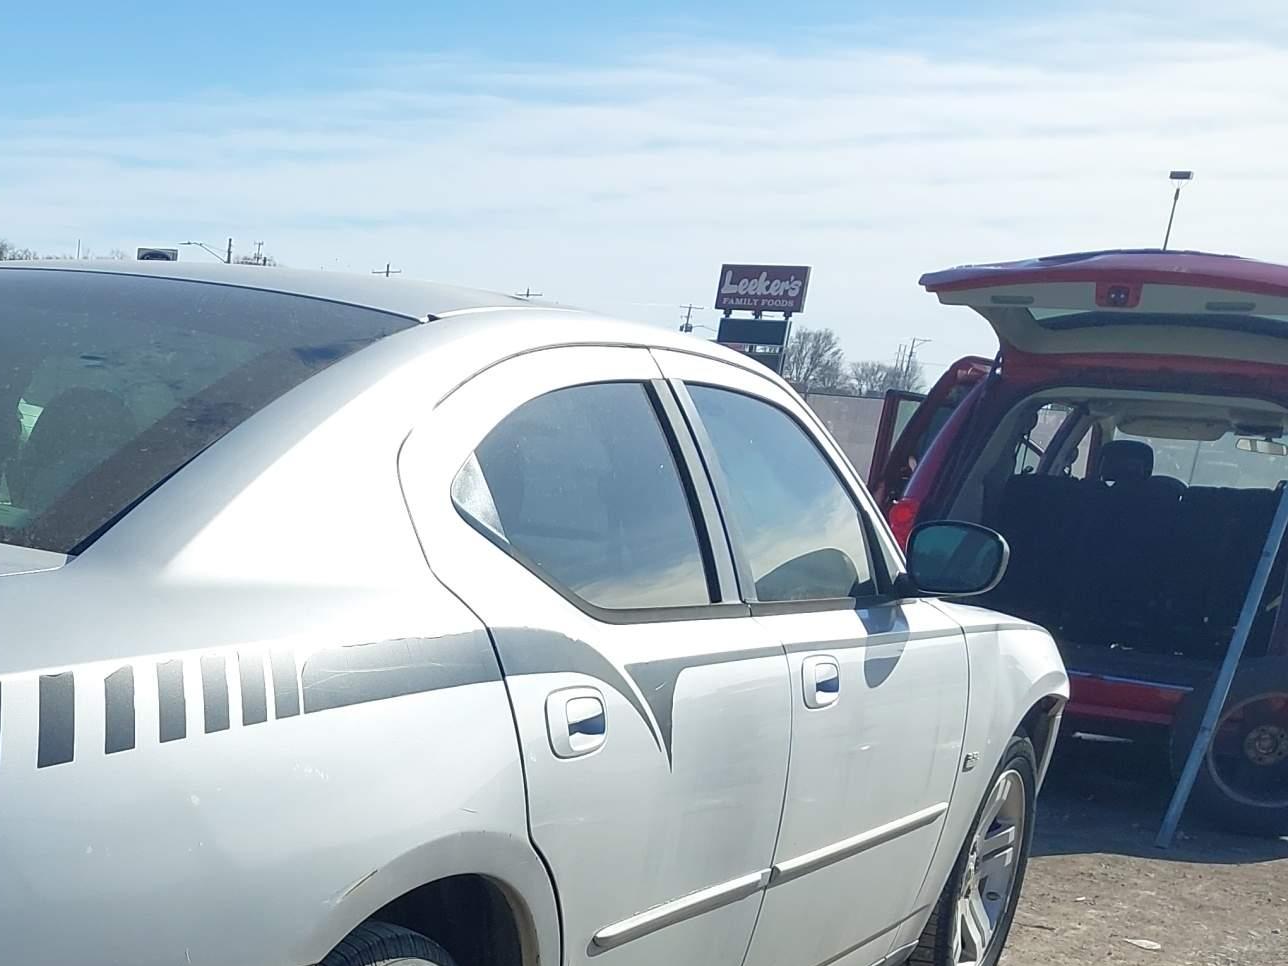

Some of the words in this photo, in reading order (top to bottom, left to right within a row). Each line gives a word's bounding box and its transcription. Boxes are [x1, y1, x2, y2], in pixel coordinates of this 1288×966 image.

[720, 270, 802, 297] Leeker's
[722, 297, 759, 306] FAMILY
[760, 298, 794, 307] FOODS
